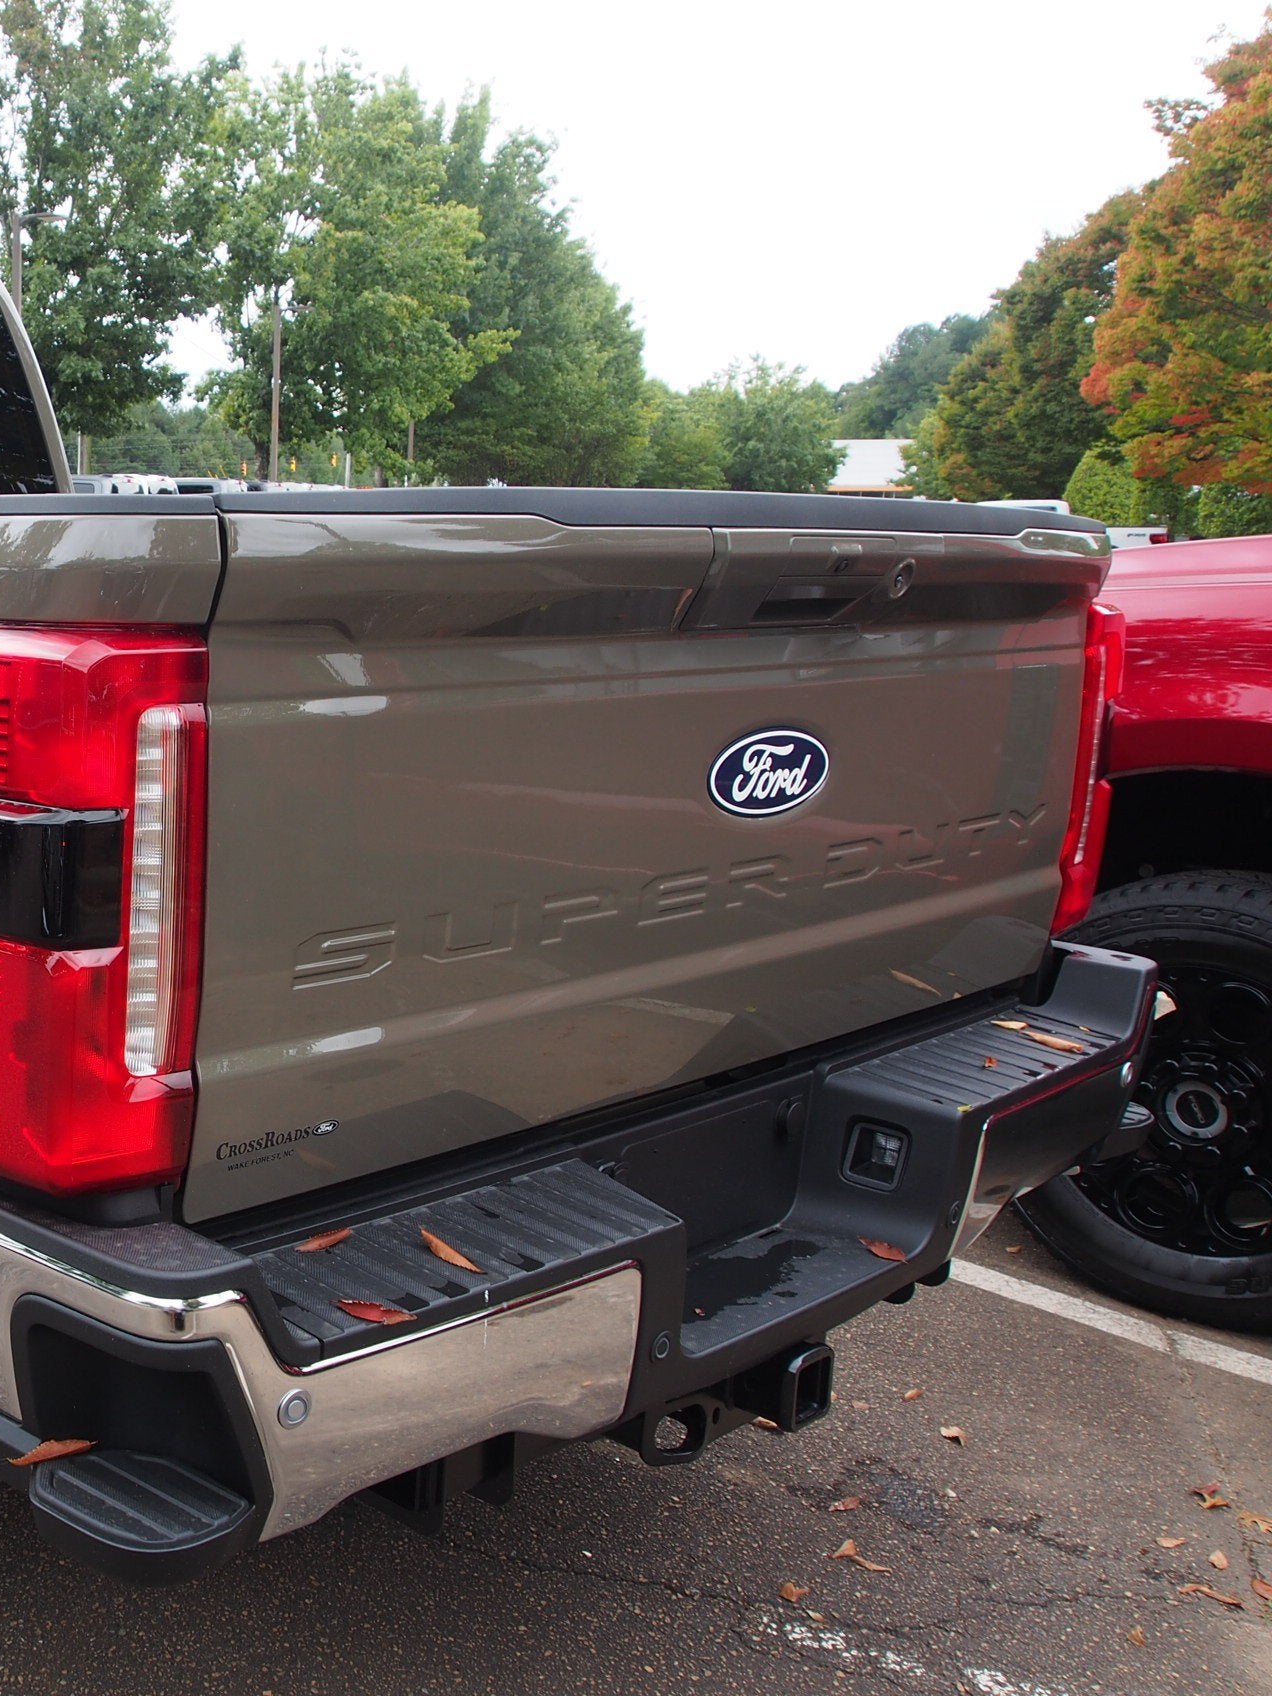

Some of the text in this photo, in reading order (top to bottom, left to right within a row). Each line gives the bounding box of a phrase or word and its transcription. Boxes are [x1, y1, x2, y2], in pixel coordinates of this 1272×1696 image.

[732, 743, 811, 802] Ford
[292, 803, 1048, 990] SUPER DUTY
